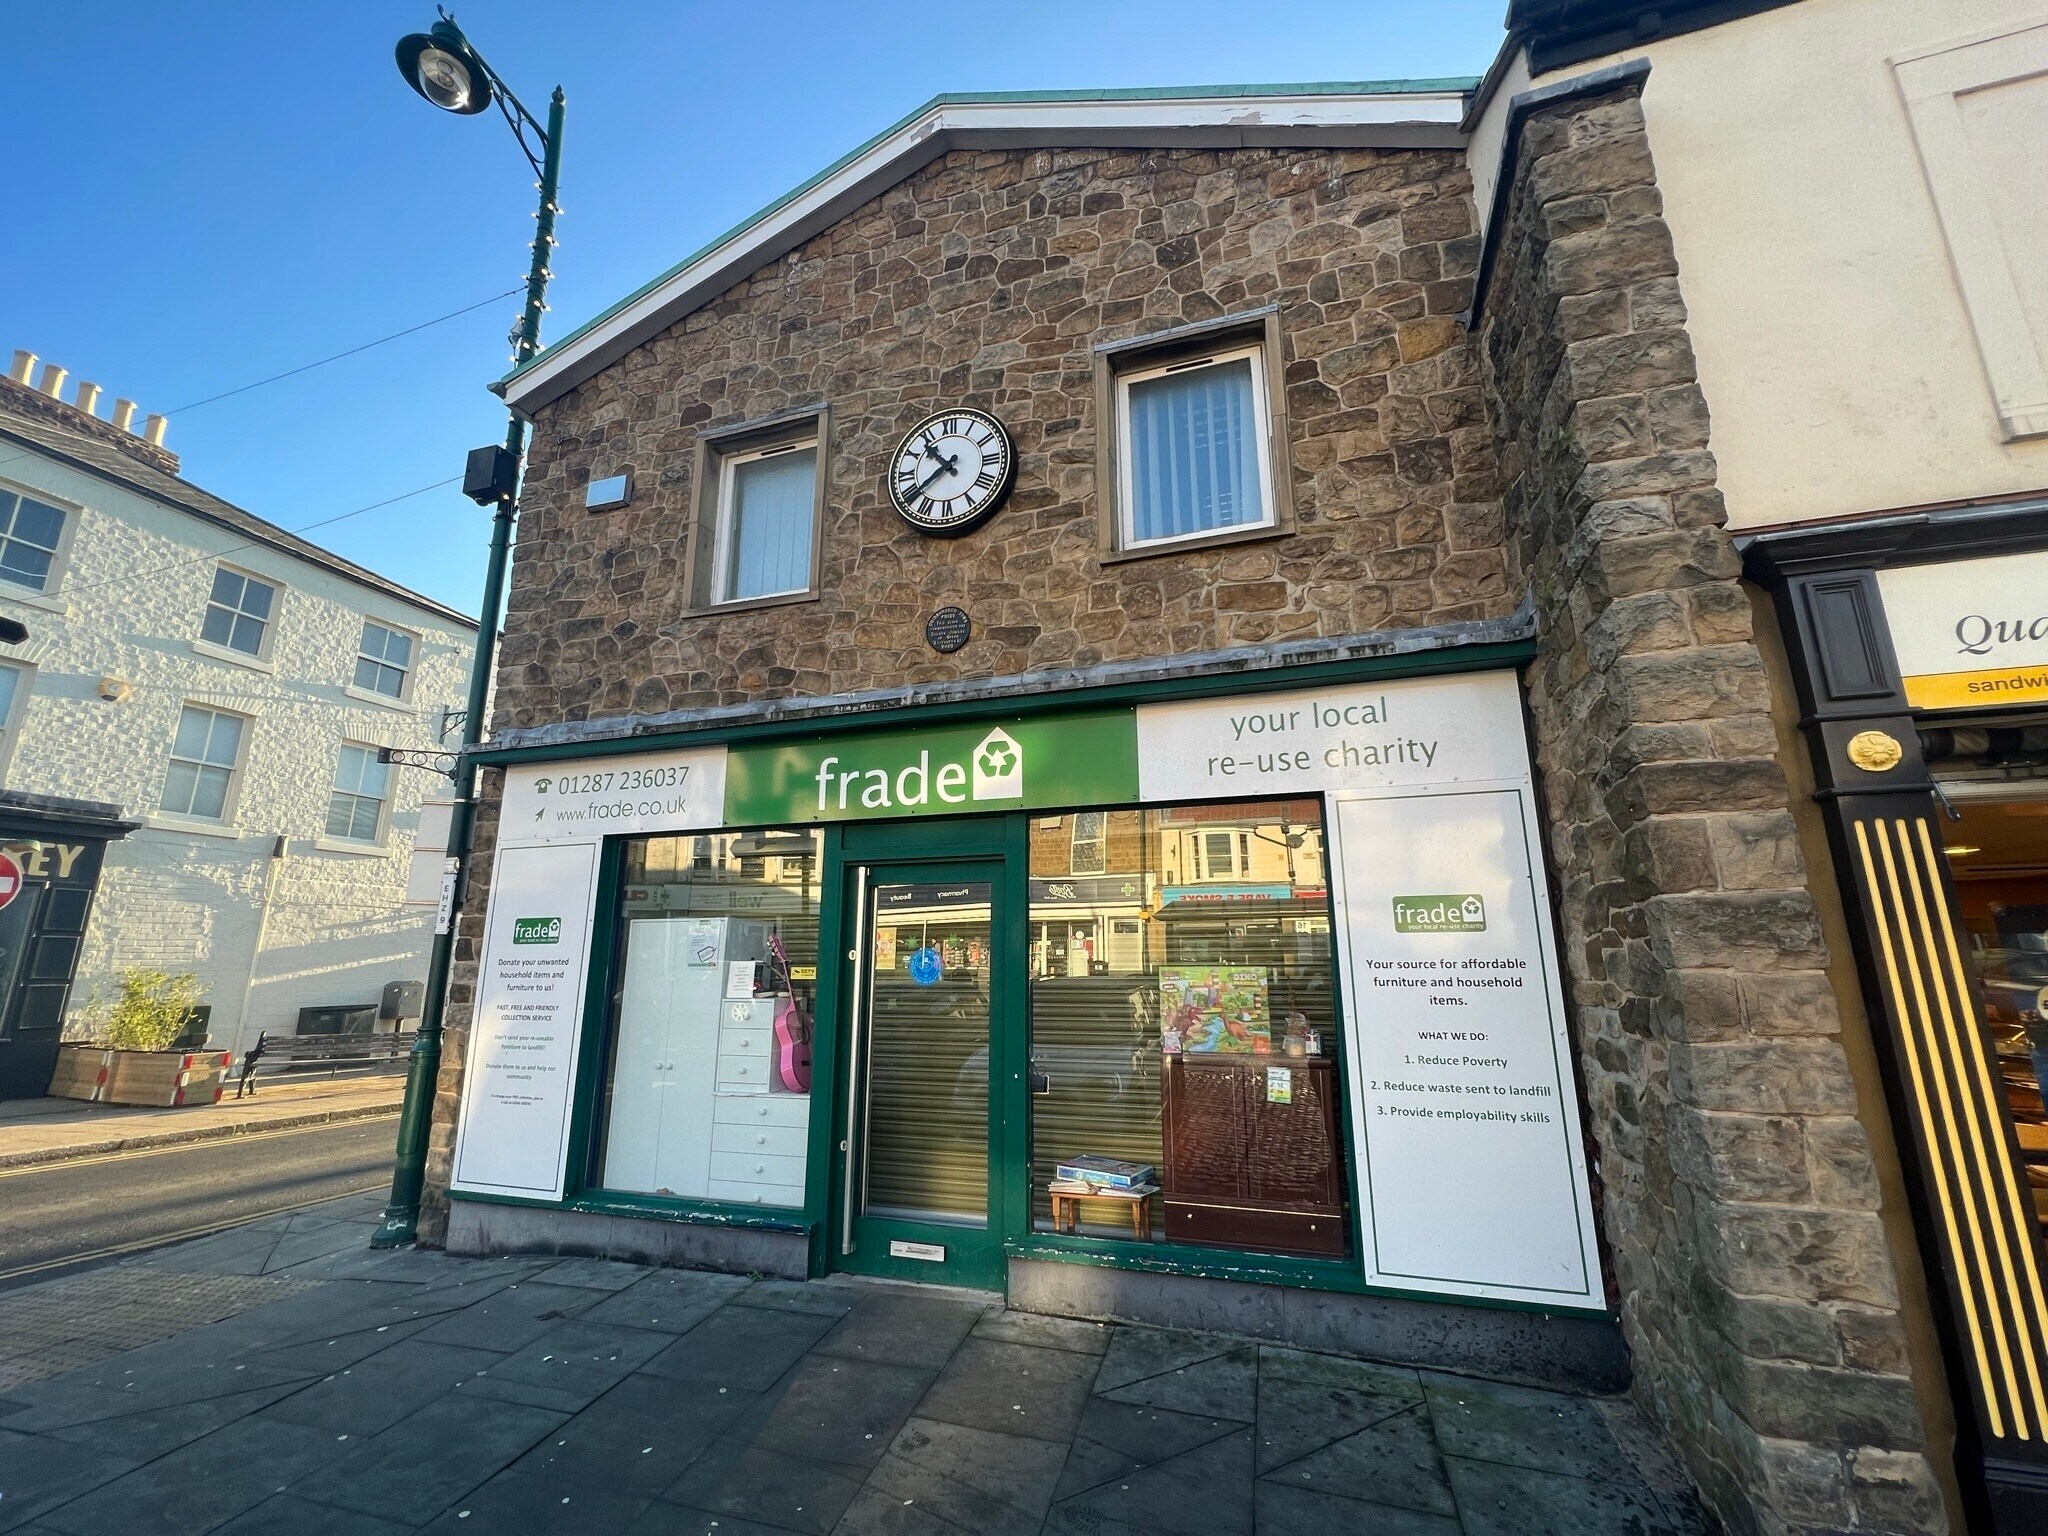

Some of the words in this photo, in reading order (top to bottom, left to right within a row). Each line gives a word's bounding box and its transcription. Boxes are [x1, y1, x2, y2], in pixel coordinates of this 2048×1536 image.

[1230, 711, 1300, 741] your
[1313, 696, 1387, 728] local
[1208, 750, 1311, 776] re-use
[1324, 737, 1438, 767] charity
[558, 773, 614, 795] 01287
[619, 766, 690, 790] 236037
[815, 750, 967, 811] frade
[557, 796, 687, 821] www.frade.co.uk
[1395, 903, 1461, 923] frade
[515, 923, 549, 938] frade
[537, 958, 569, 966] unwanted
[1366, 959, 1394, 969] Your
[1397, 960, 1437, 969] source
[1440, 959, 1458, 969] for
[1461, 958, 1527, 969] affordable
[1373, 977, 1427, 987] furniture
[1430, 976, 1453, 987] and
[1456, 976, 1523, 988] household
[1429, 995, 1468, 1006] items.
[1418, 1032, 1448, 1040] WHAT
[1450, 1032, 1467, 1041] WE
[1470, 1032, 1489, 1041] DO:
[1404, 1055, 1414, 1064] 1.
[1417, 1055, 1459, 1066] Reduce
[1462, 1056, 1508, 1069] Poverty
[1370, 1081, 1381, 1090] 2.
[1383, 1081, 1425, 1092] Reduce
[1428, 1084, 1462, 1093] waste
[1465, 1085, 1491, 1095] sent
[1494, 1085, 1506, 1095] to
[1509, 1085, 1551, 1097] landfill
[1376, 1106, 1388, 1116] 3.
[1390, 1106, 1434, 1118] Provide
[1436, 1109, 1517, 1124] employability
[1520, 1112, 1551, 1123] skills
